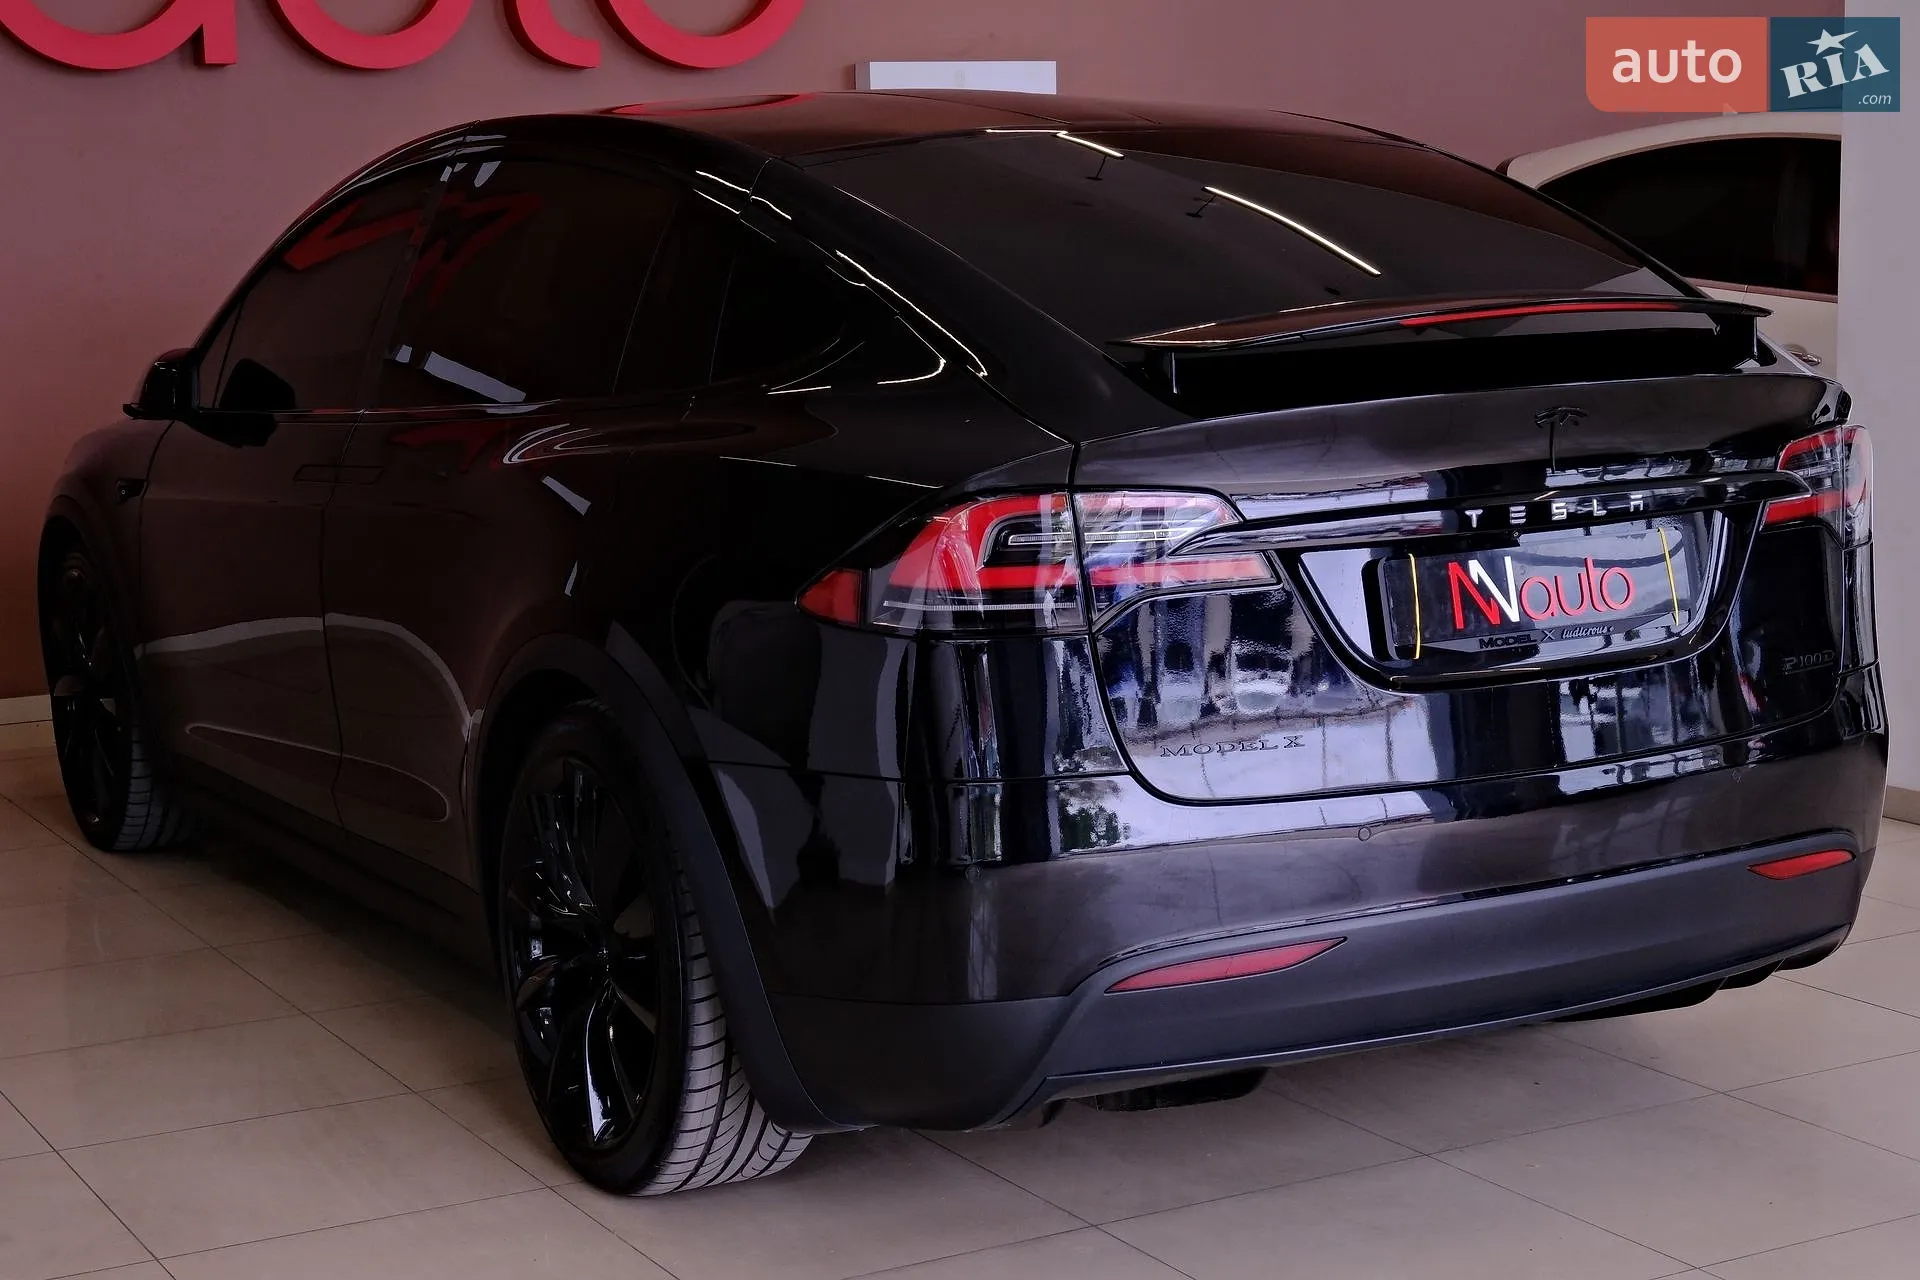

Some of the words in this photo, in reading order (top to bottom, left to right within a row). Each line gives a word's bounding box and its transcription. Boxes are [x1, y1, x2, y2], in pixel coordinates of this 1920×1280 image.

[1464, 494, 1645, 528] TESLA
[1479, 634, 1537, 649] MODEL
[1542, 629, 1556, 641] X
[1782, 649, 1836, 671] P100D
[1160, 738, 1279, 758] MODEL
[1283, 734, 1306, 749] X
